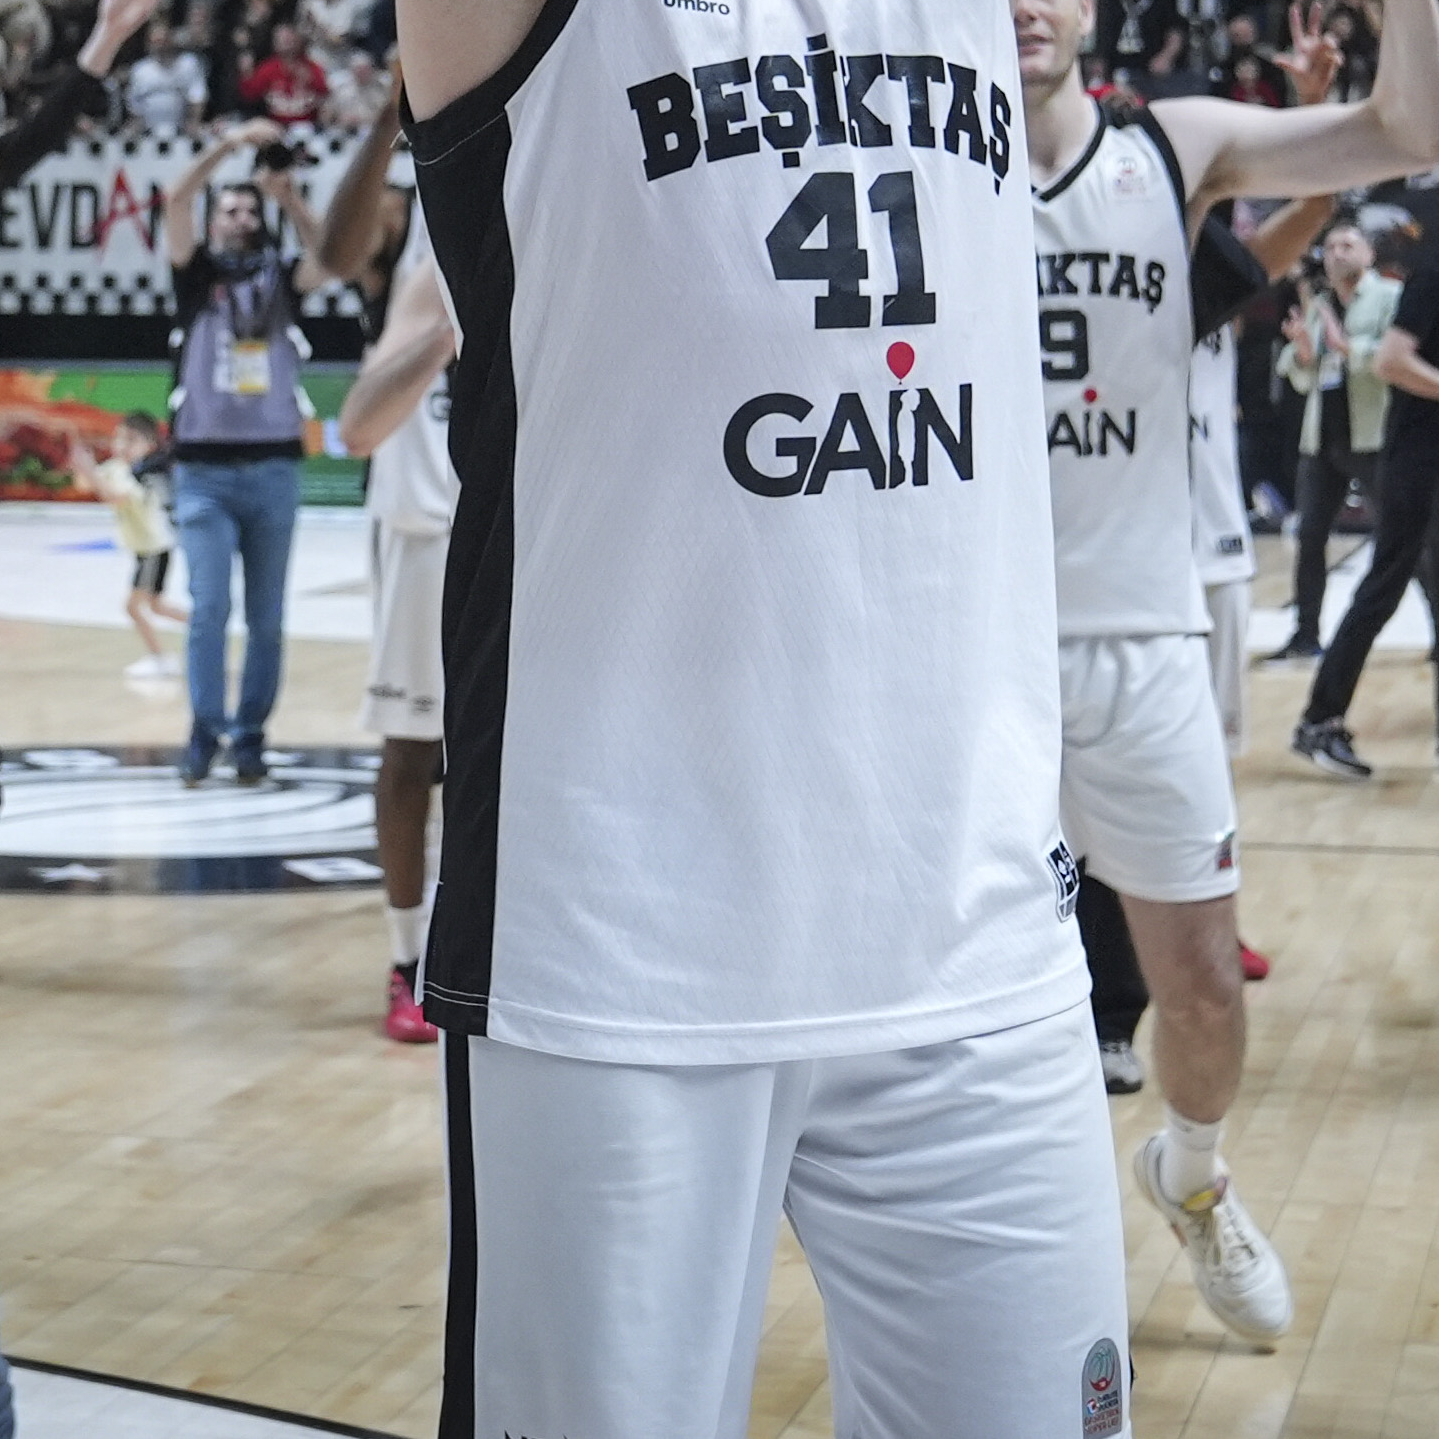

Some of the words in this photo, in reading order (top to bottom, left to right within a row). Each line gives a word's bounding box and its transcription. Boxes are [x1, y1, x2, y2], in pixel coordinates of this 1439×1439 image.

[627, 33, 1011, 196] BEŞİKTAŞ
[765, 171, 936, 329] 41
[1039, 309, 1089, 381] 9
